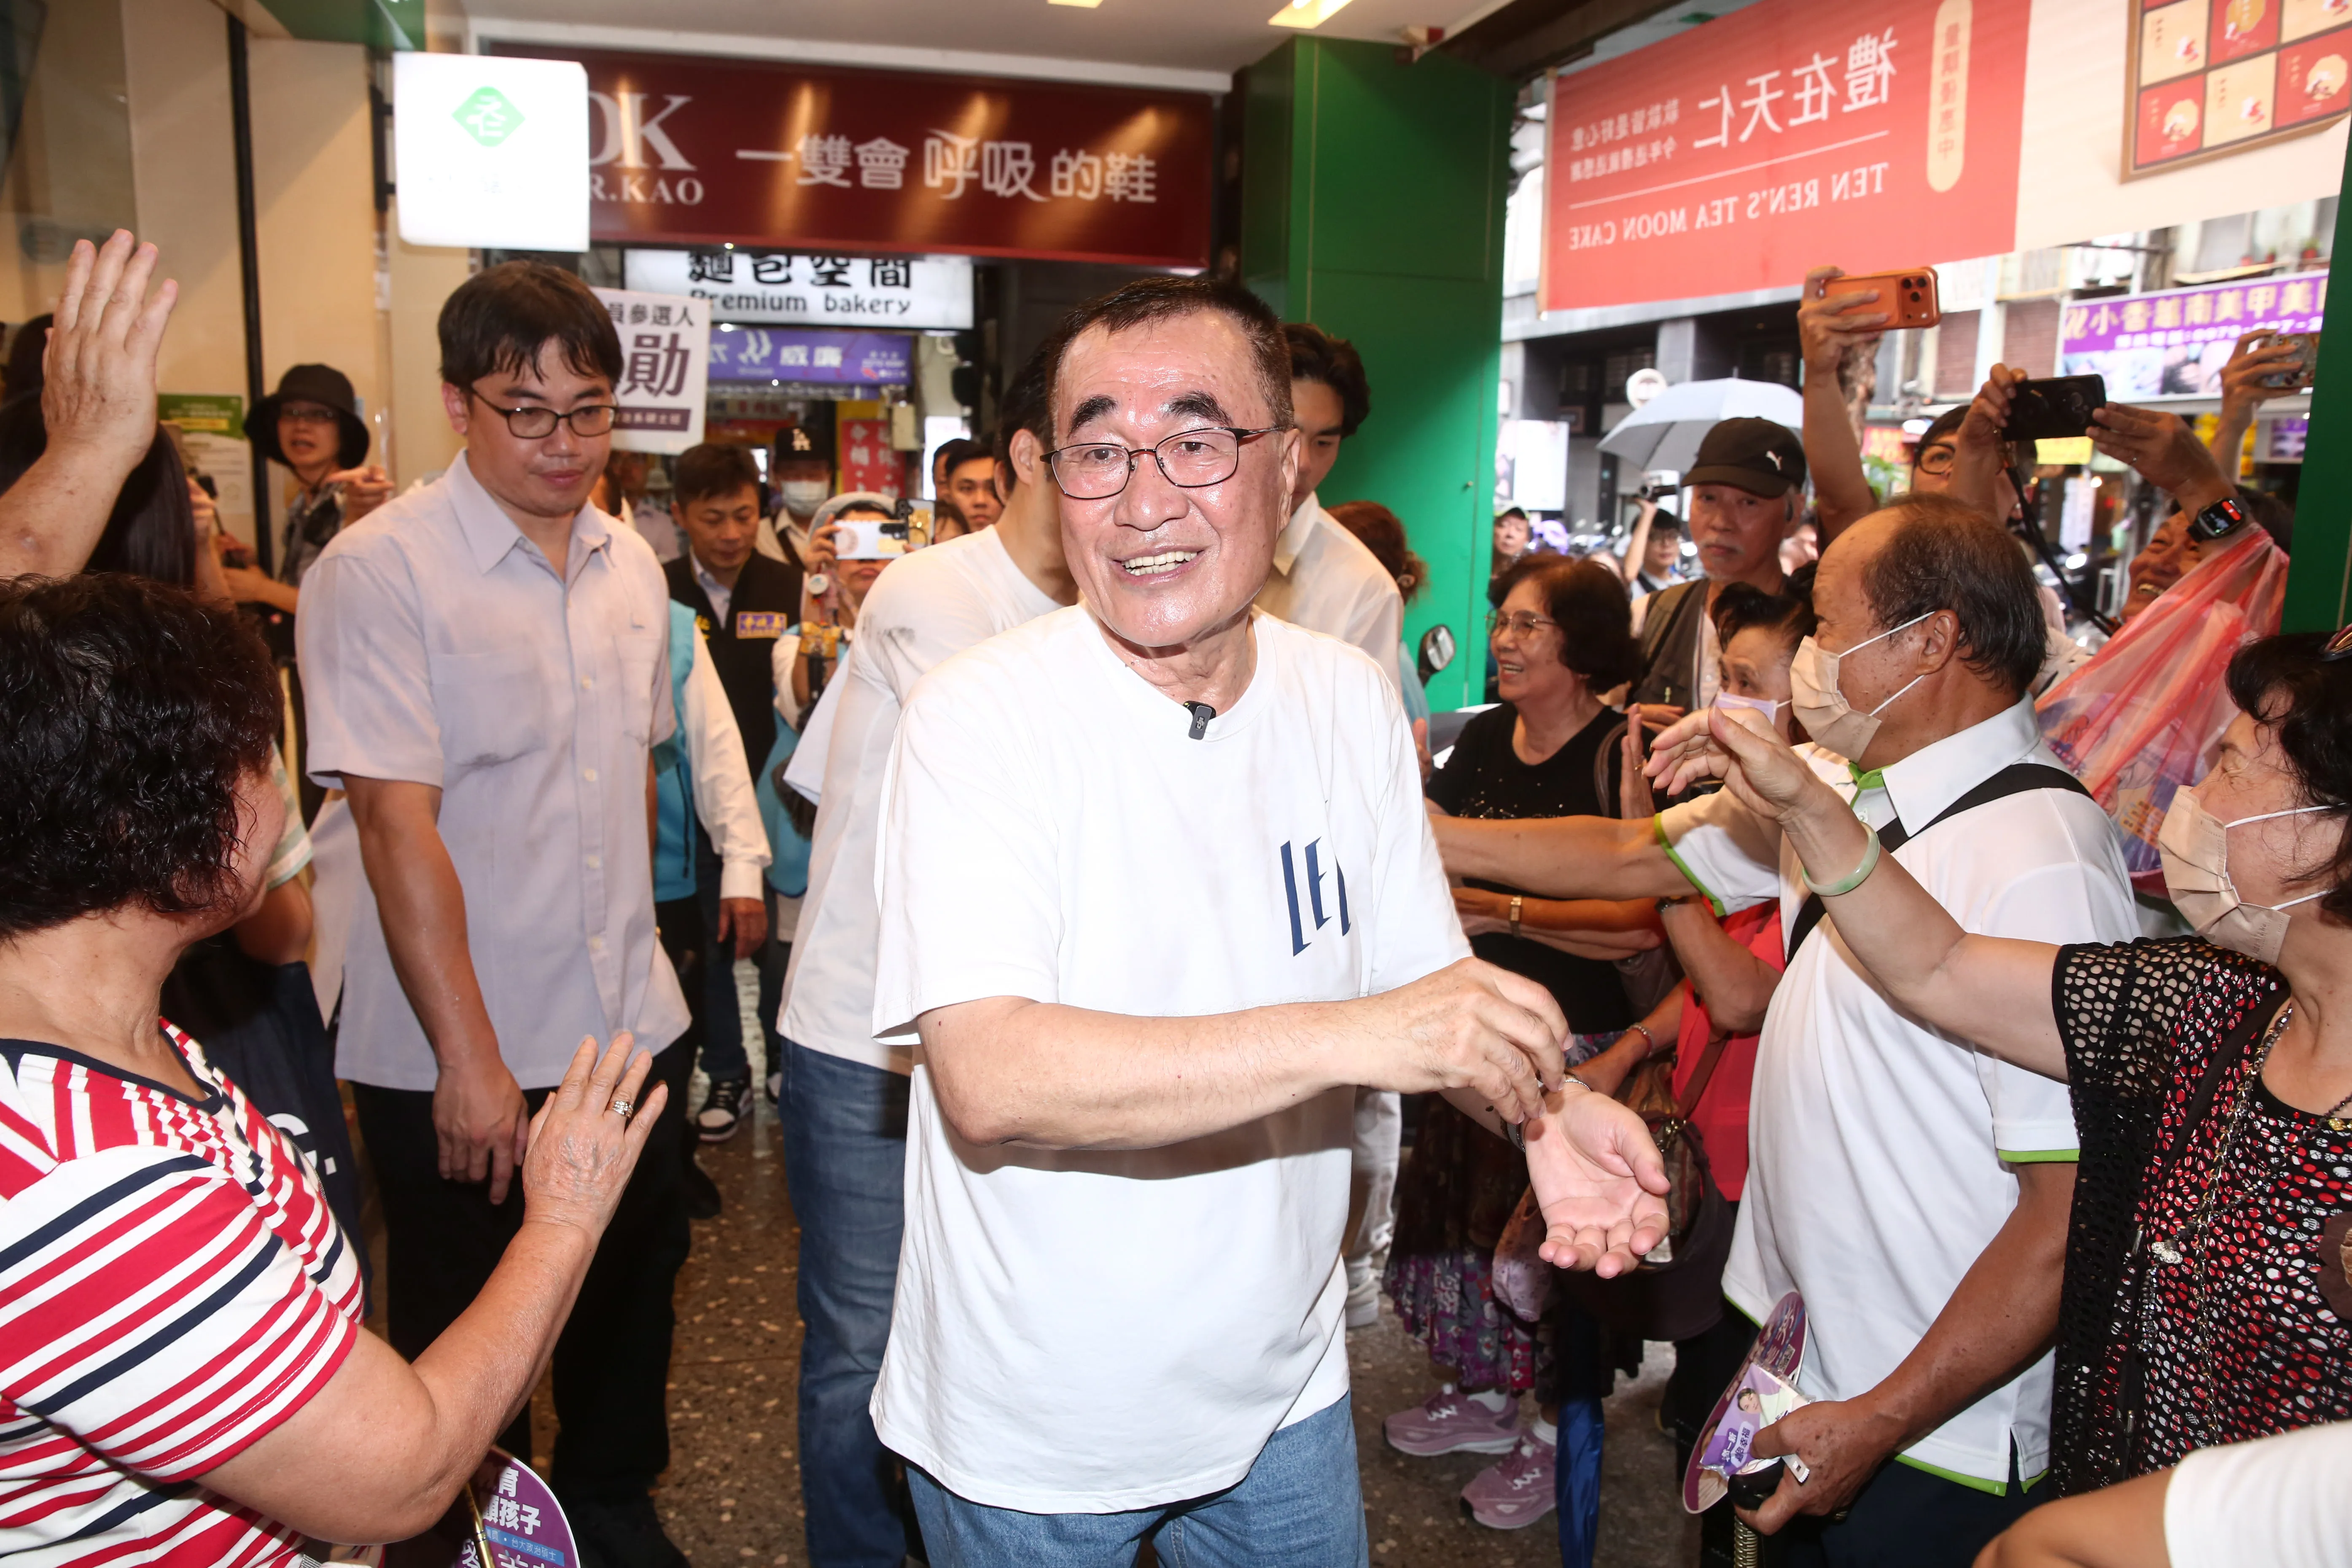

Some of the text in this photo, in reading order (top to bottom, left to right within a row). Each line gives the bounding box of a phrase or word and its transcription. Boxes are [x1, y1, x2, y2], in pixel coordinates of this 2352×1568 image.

[736, 128, 1158, 203] 一雙會呼吸的鞋
[825, 293, 911, 315] bakery
[622, 333, 690, 397] 勛
[511, 1538, 557, 1561] 台大政治碩士
